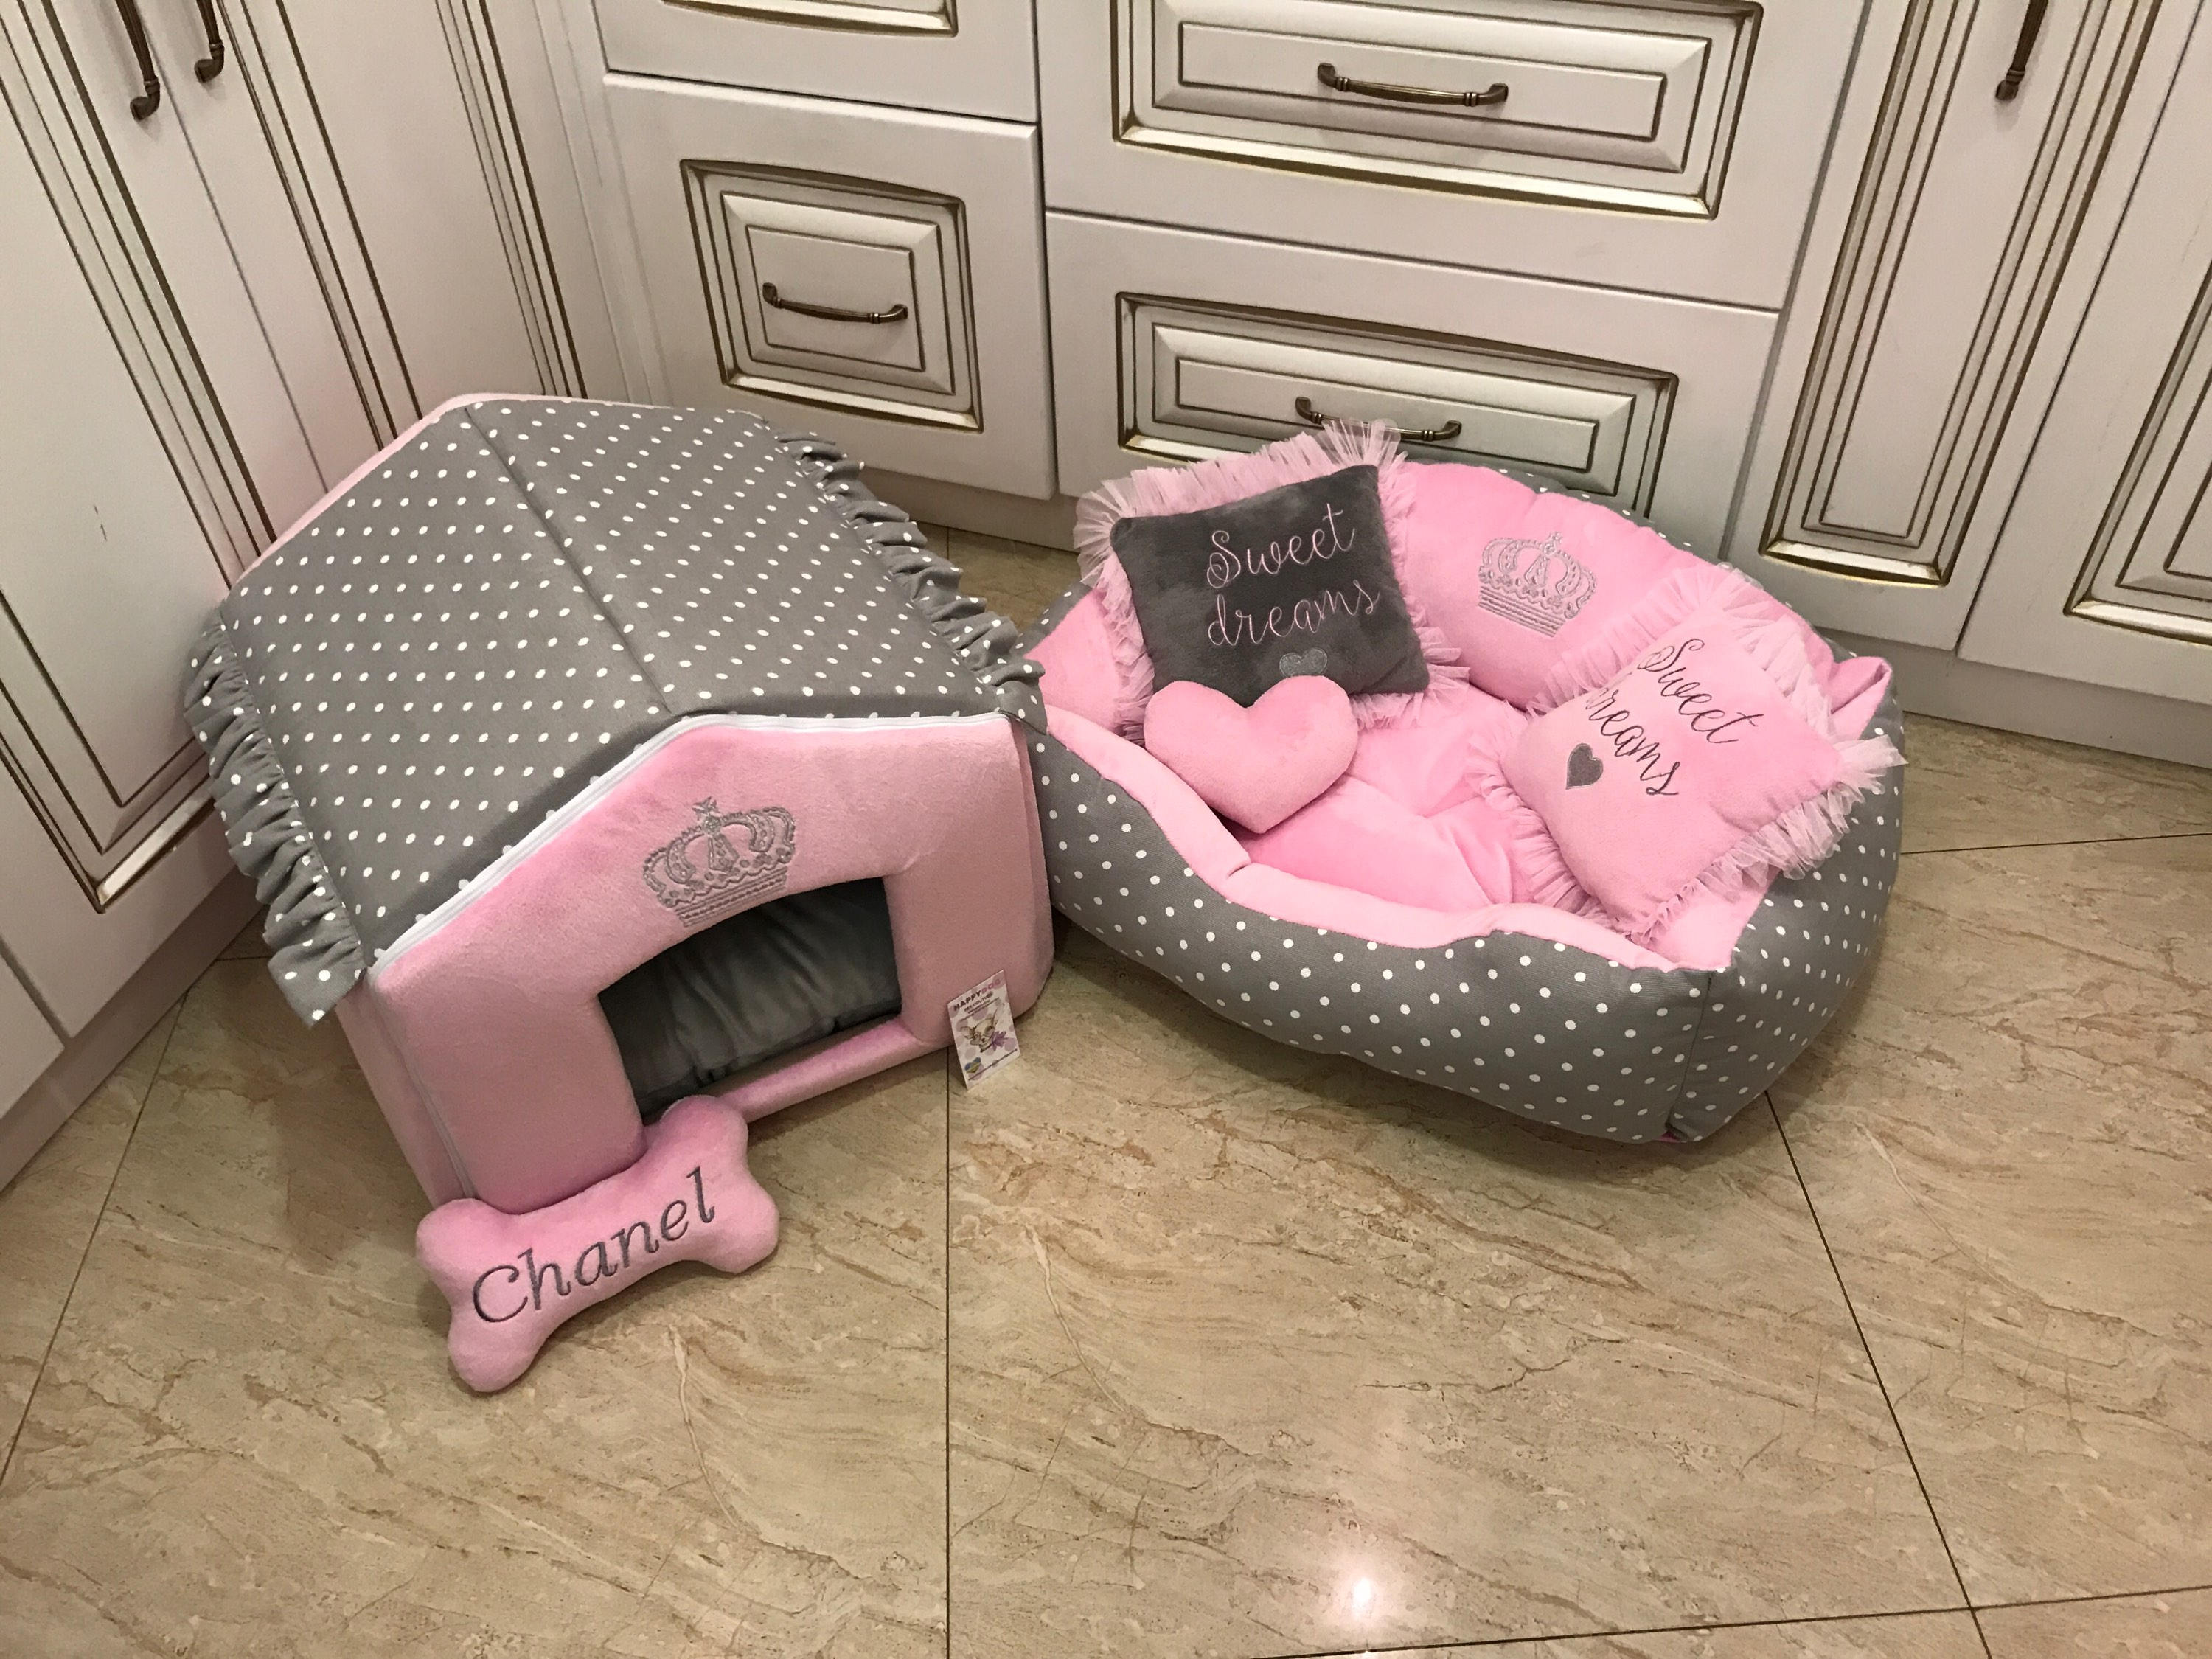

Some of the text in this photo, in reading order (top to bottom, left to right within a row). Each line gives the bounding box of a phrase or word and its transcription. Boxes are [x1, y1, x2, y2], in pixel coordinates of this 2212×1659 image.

[1207, 503, 1355, 588] Sweet
[1208, 580, 1380, 646] dreams
[1637, 639, 1764, 743] Sweet
[473, 1166, 715, 1323] Chanel
